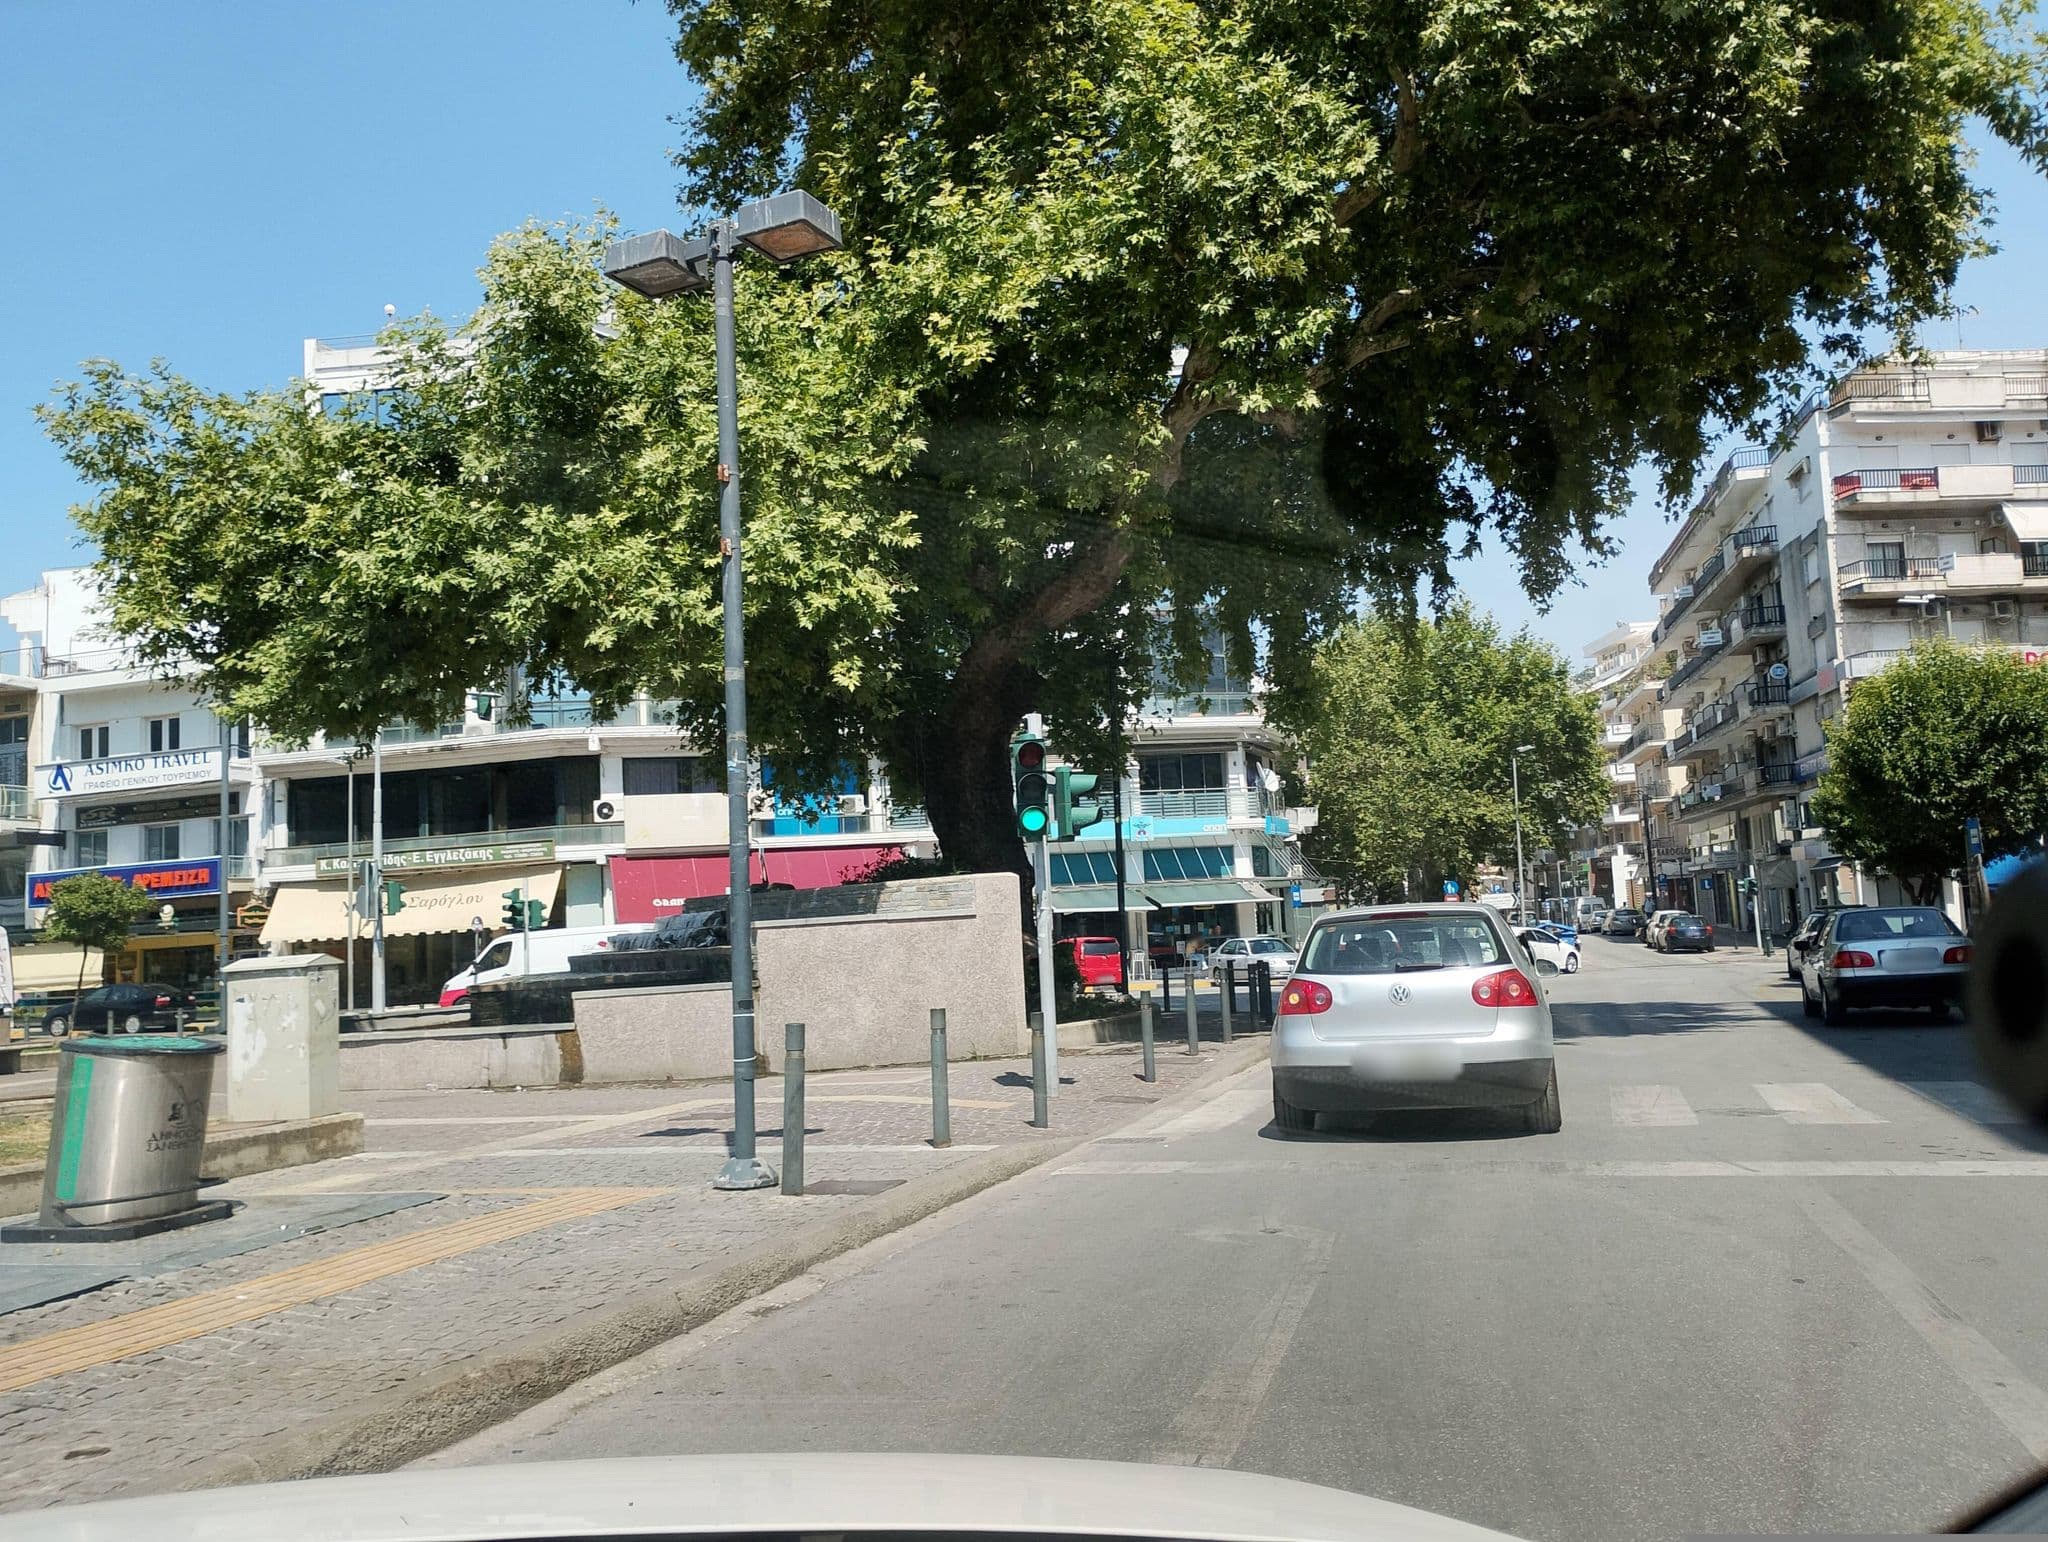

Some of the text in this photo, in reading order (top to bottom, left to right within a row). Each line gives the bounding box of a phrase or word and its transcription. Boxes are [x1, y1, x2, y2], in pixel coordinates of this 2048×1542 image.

[84, 751, 212, 776] ASIMKO TRAVEL
[83, 770, 212, 790] ΓΡΑΦΕΙΟ ΓΕΝΙΚΟΥ ΤΟΥΡΙΣΜΟΥ
[426, 848, 493, 864] Εγγλεζάκης
[408, 893, 484, 910] Σαρόγλου
